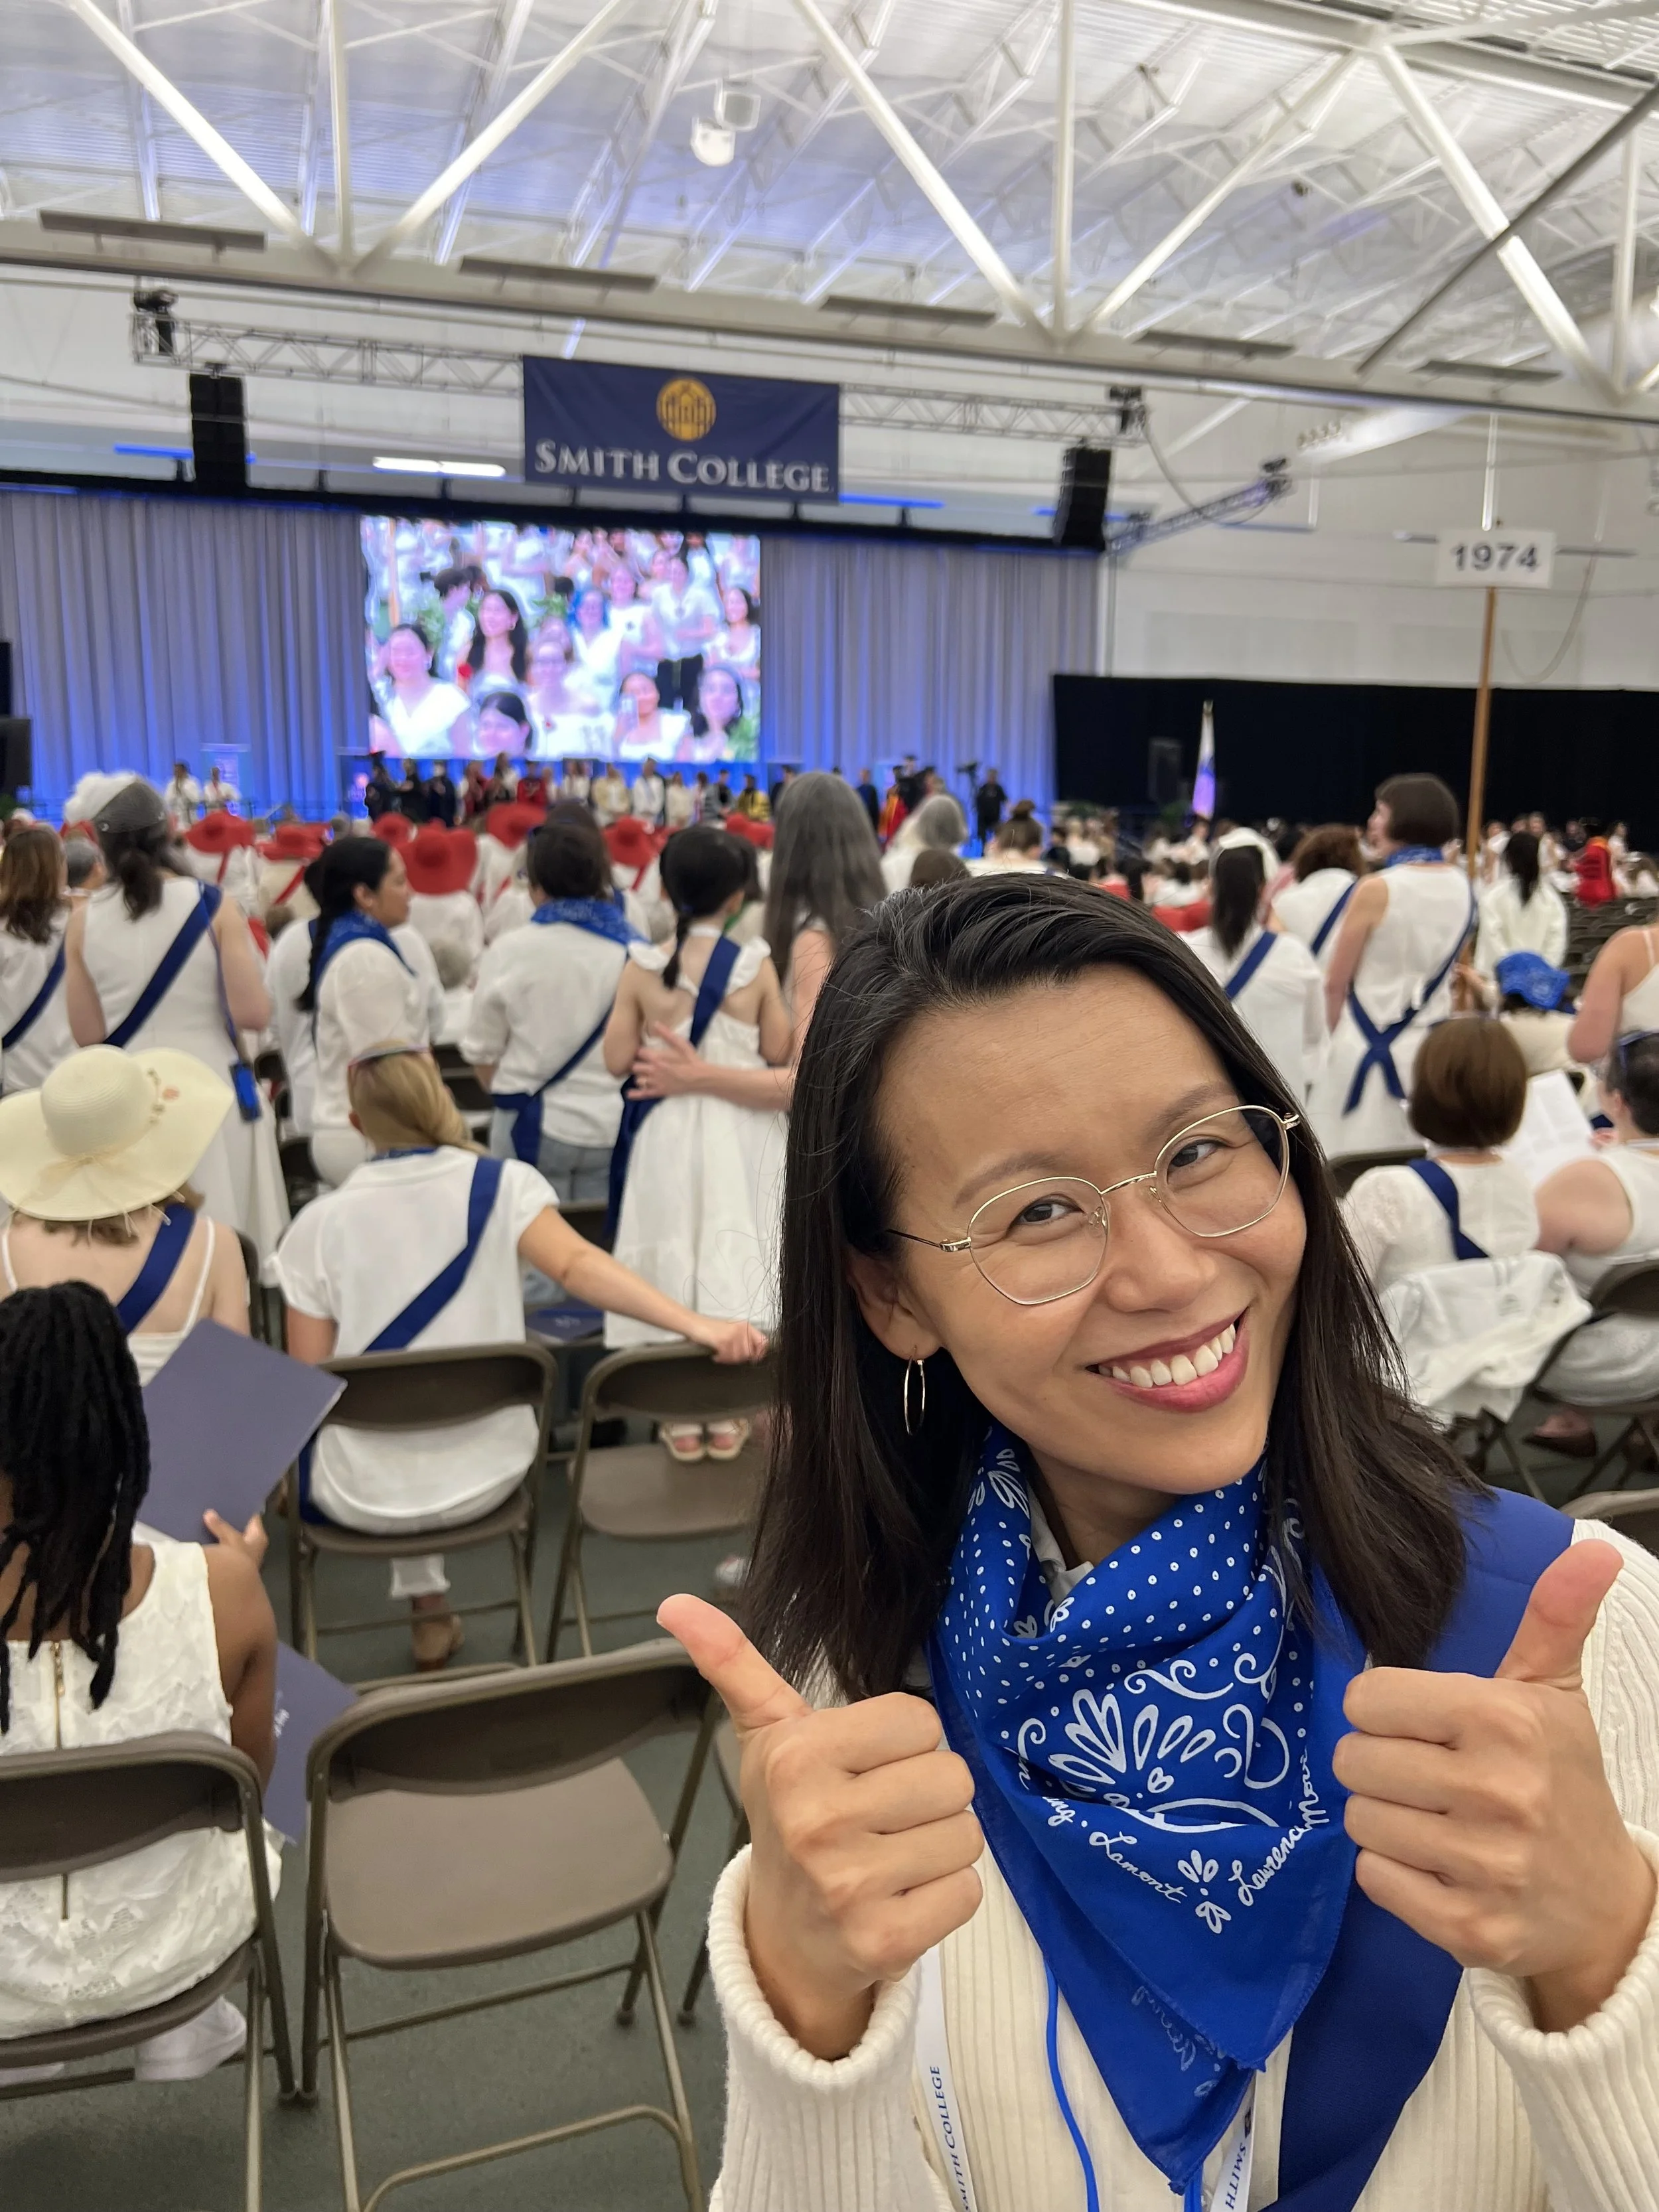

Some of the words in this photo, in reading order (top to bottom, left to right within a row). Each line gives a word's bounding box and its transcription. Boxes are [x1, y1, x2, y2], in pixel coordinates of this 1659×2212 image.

[534, 438, 660, 481] SMITH
[668, 449, 830, 493] COLLEGE
[1450, 541, 1540, 572] 1974
[1089, 1830, 1188, 1903] Lamont
[930, 2065, 956, 2149] COLLEGE
[1225, 2142, 1246, 2209] SMITH
